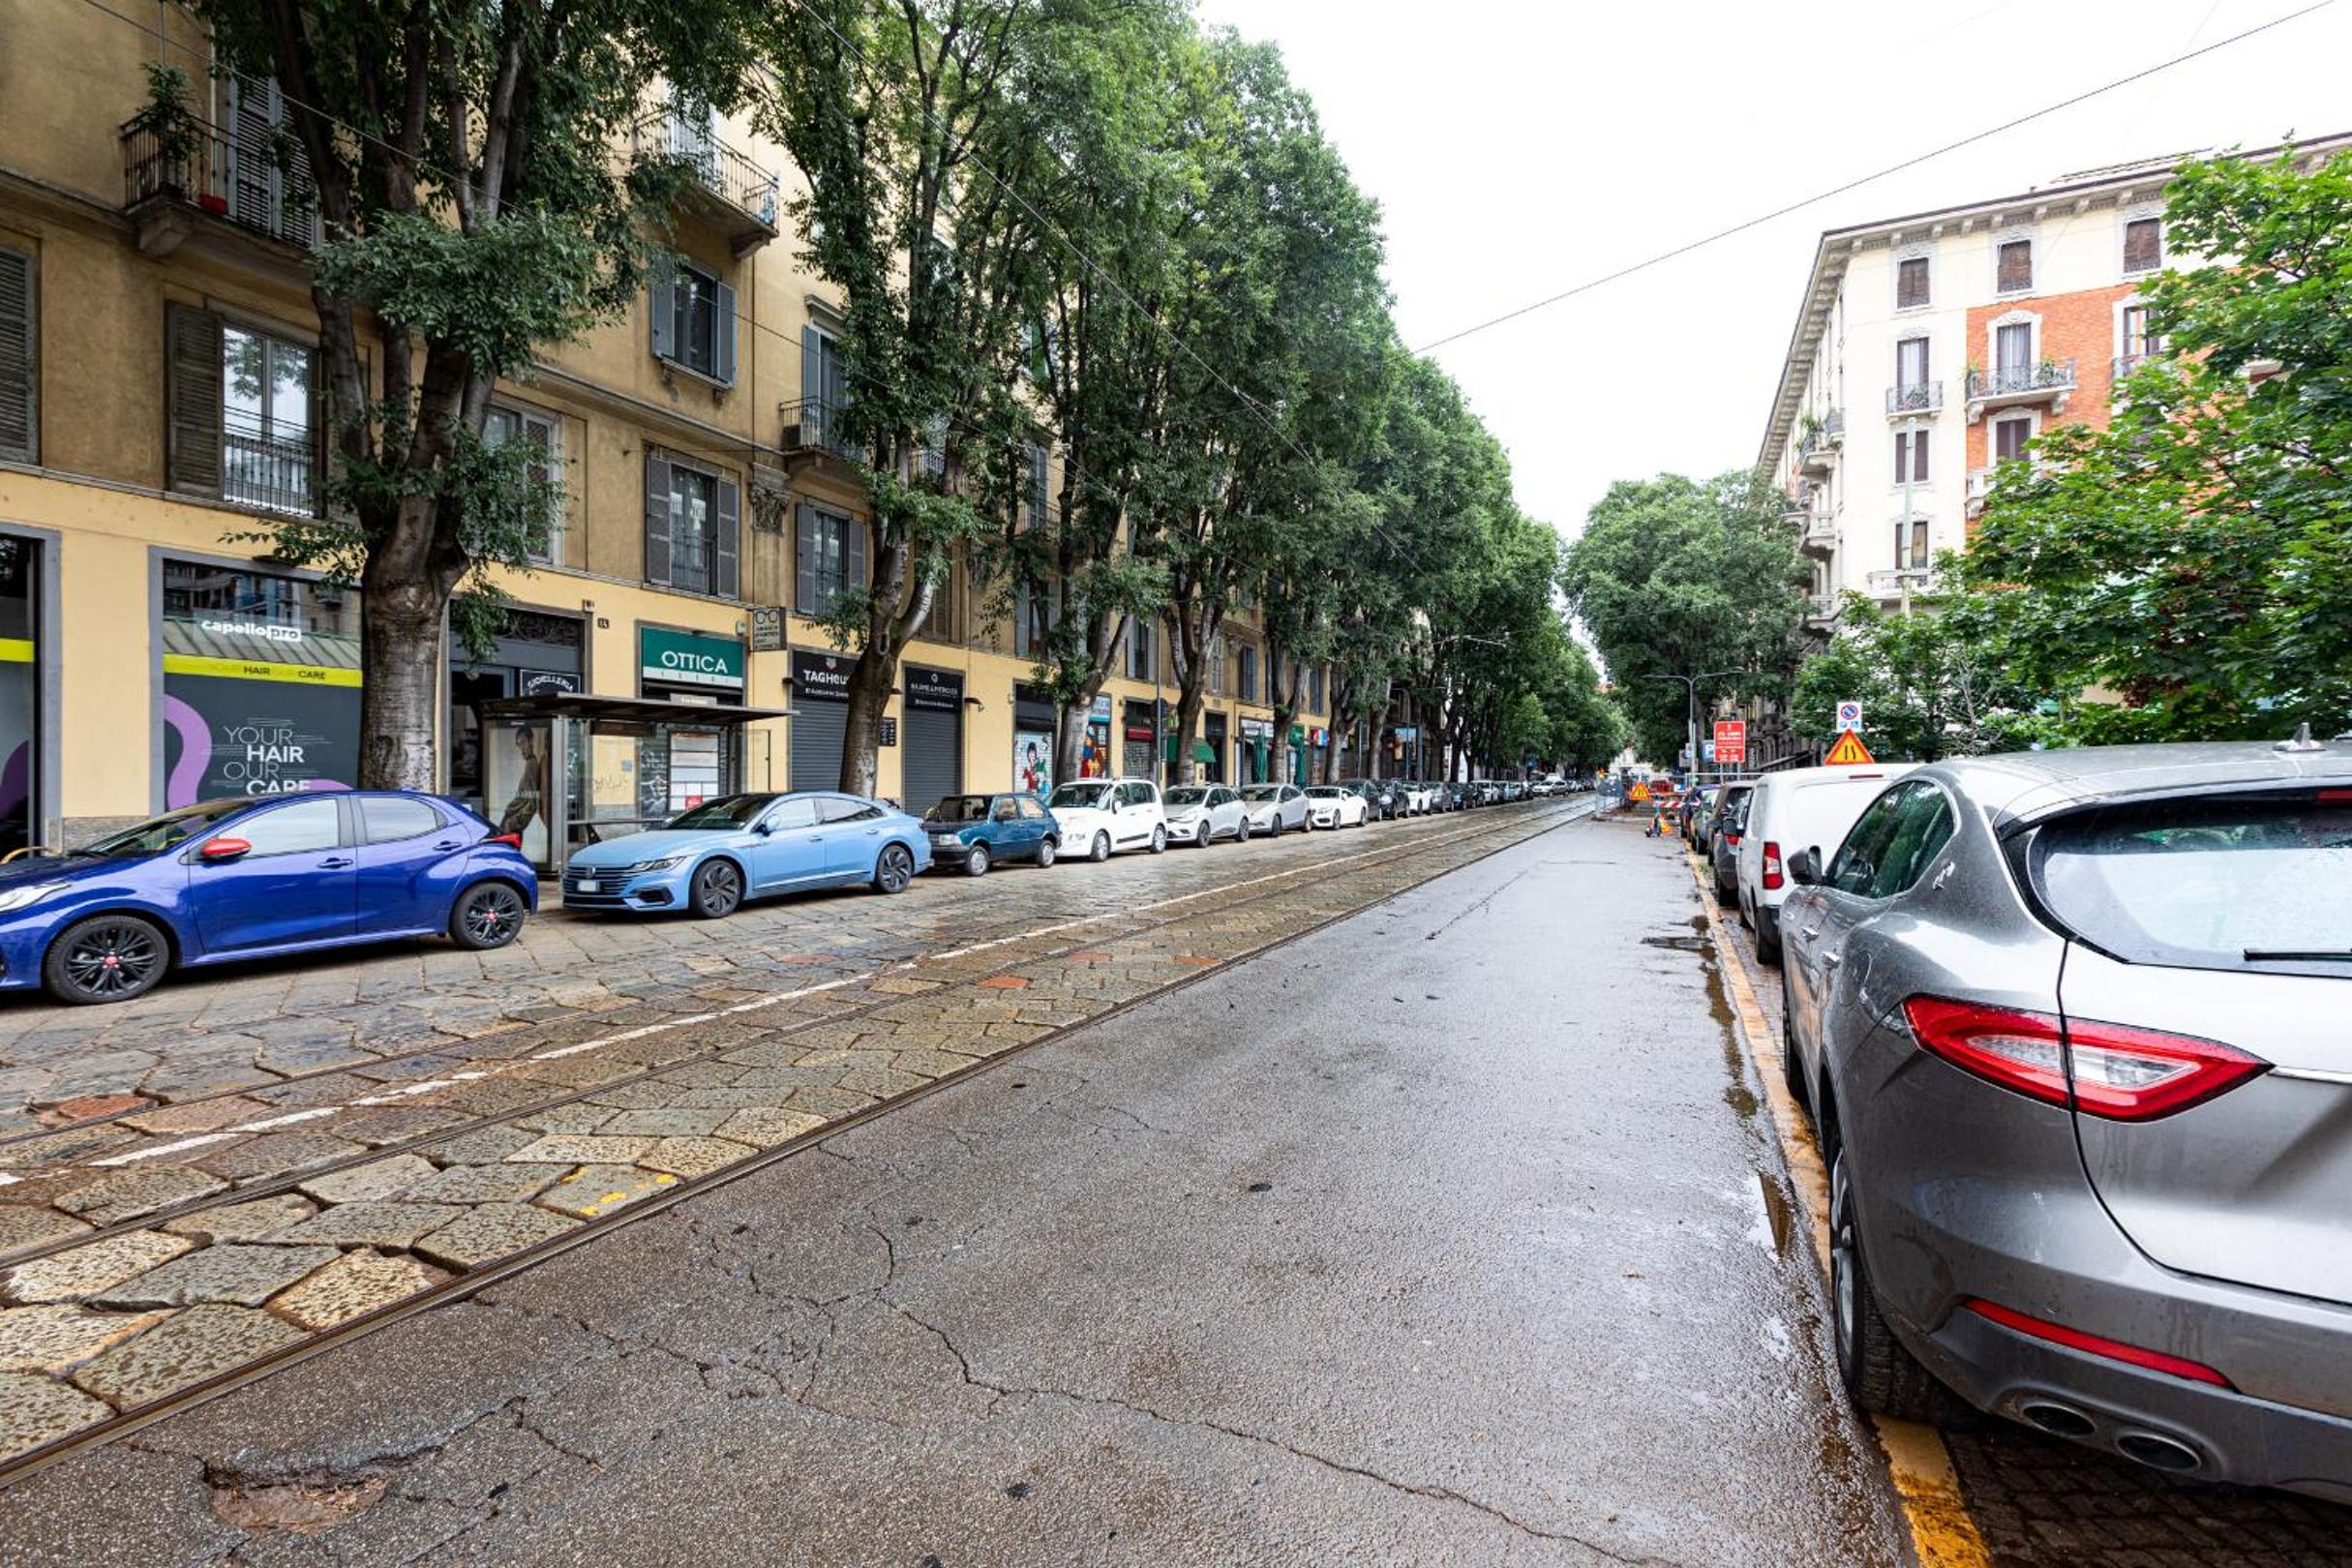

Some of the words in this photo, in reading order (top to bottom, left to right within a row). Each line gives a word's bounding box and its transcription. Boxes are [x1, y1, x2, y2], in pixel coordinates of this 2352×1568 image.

[661, 650, 728, 674] OTTICA
[243, 666, 271, 676] HAIR
[298, 670, 326, 679] CARE
[223, 726, 293, 745] YOUR
[247, 744, 304, 763] HAIR
[224, 762, 280, 780] OUR
